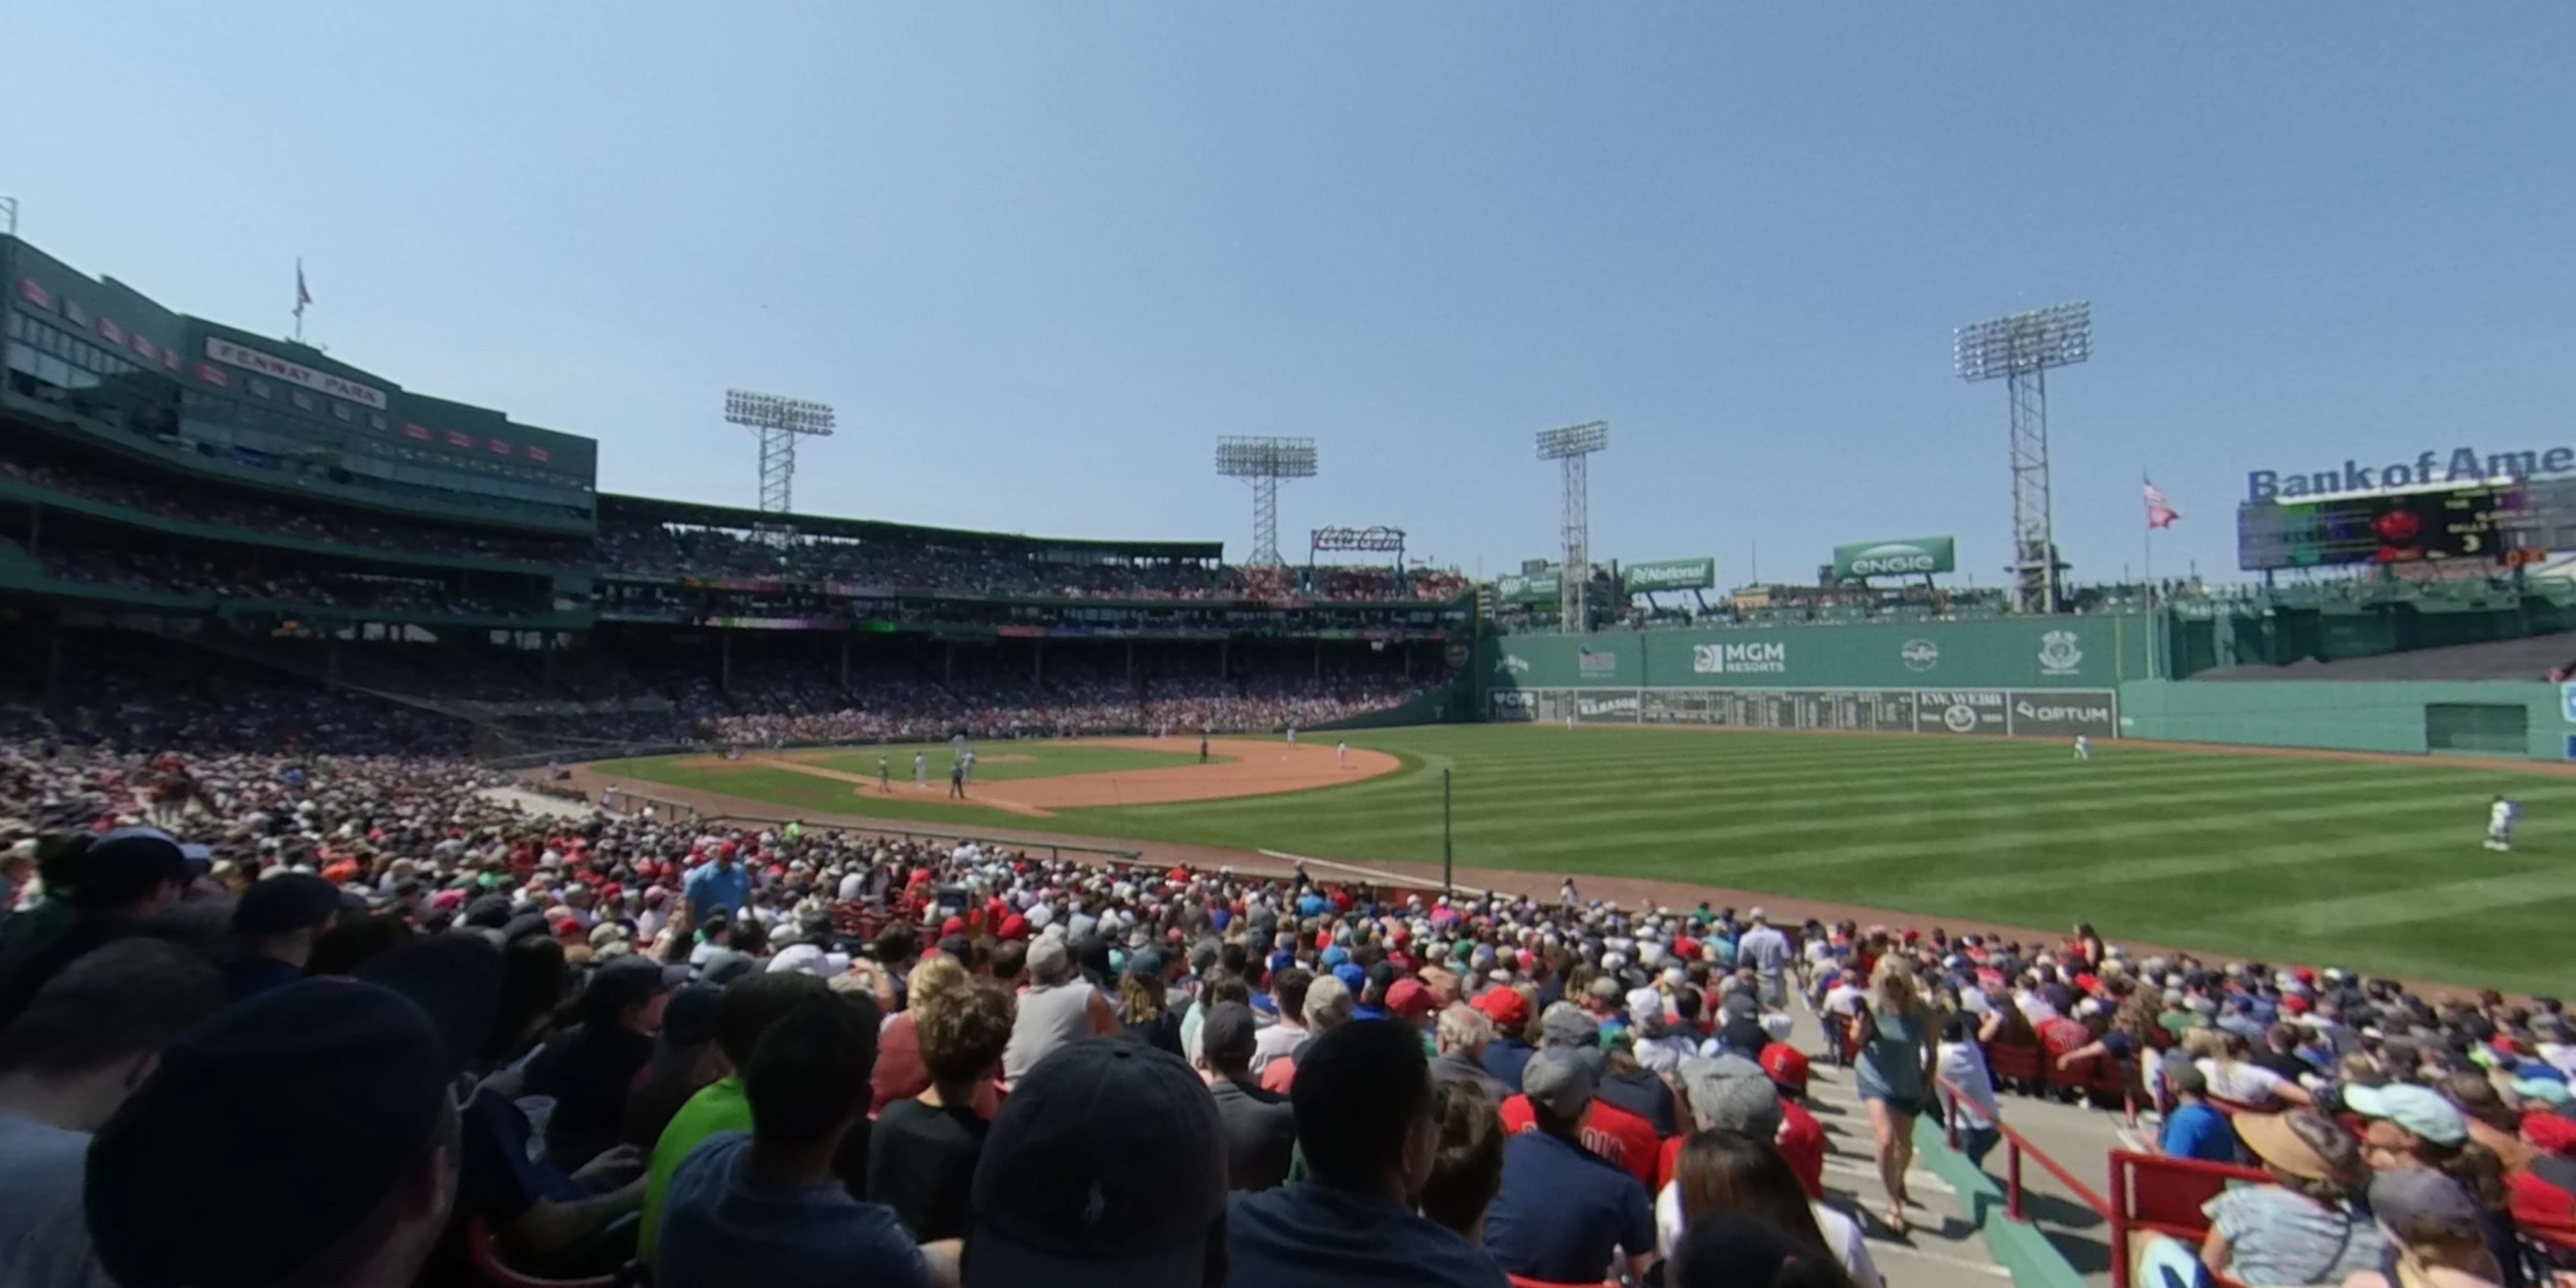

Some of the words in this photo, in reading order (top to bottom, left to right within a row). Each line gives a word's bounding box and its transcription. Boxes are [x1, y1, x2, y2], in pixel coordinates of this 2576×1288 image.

[220, 344, 313, 382] FENWAY
[325, 377, 377, 403] PARK
[2248, 459, 2373, 502] Bank
[2380, 450, 2437, 490] of
[2462, 534, 2481, 552] 3
[1647, 564, 1706, 582] National
[1726, 642, 1785, 661] MGM
[1726, 661, 1785, 673] RESORTS
[2036, 706, 2109, 722] OPTUM
